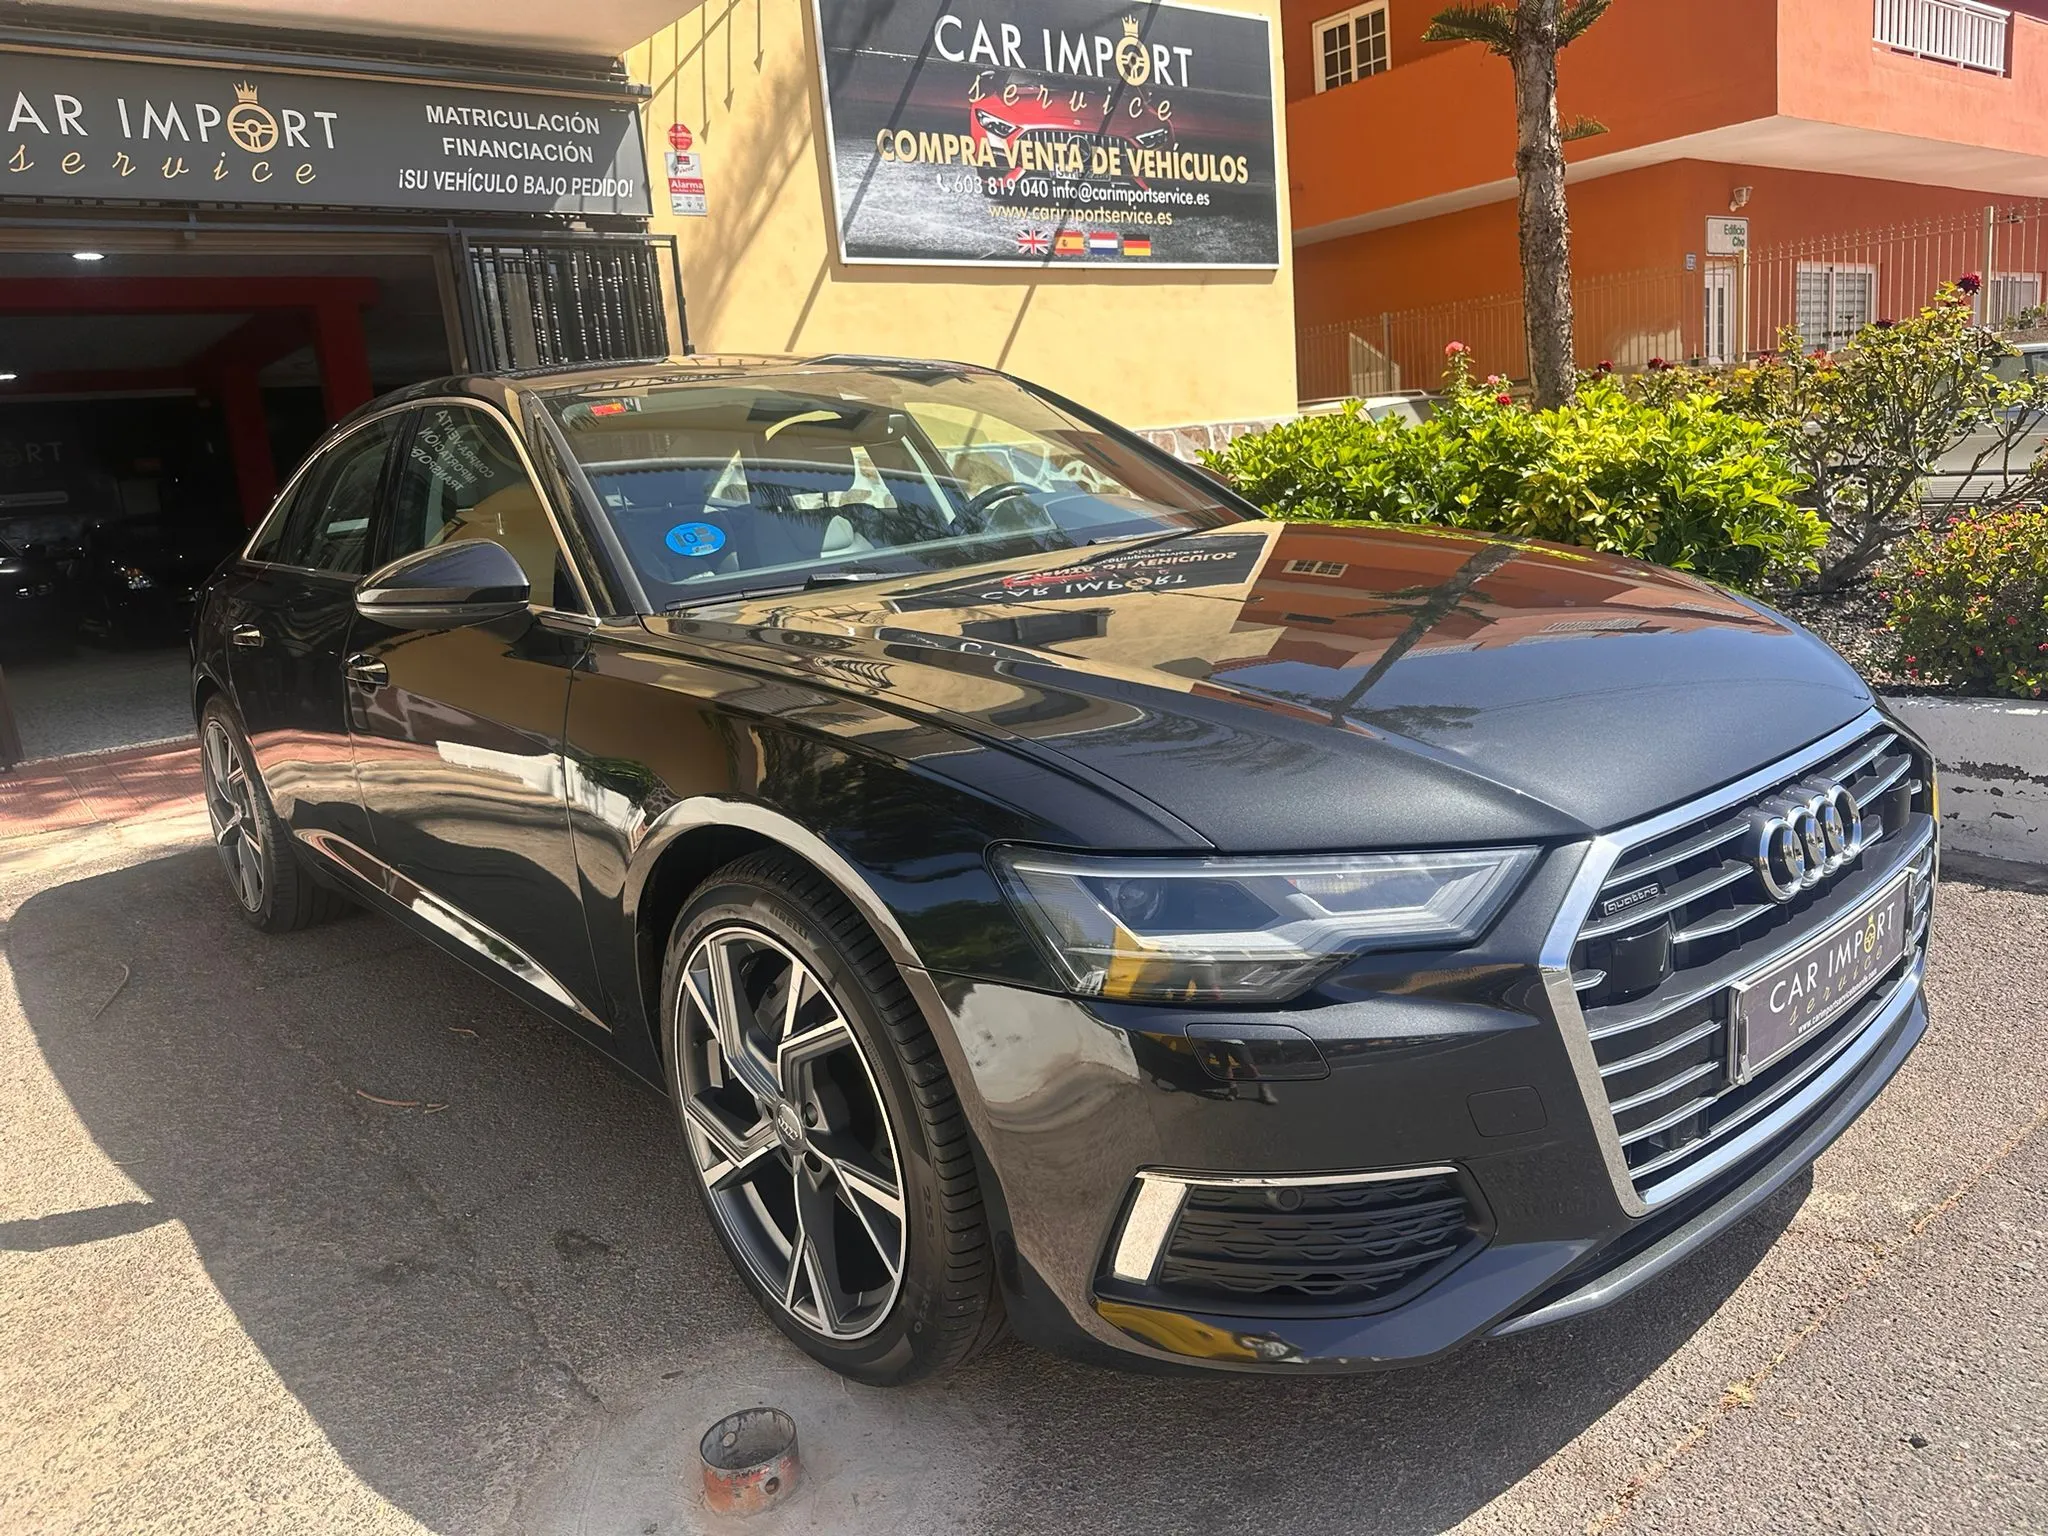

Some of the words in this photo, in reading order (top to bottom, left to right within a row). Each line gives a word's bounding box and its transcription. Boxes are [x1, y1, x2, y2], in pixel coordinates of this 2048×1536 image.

[934, 15, 1026, 69] CAR
[1042, 24, 1193, 87] IMPORT
[968, 71, 1172, 121] service
[8, 91, 88, 136] AR
[117, 94, 338, 153] IMPORT
[425, 104, 600, 135] MATRICULACIÓN
[8, 144, 316, 184] service
[442, 136, 594, 163] FINANCIACIÓN
[877, 128, 996, 168] COMPRA
[1003, 140, 1084, 173] VENTA
[1092, 147, 1122, 177] DE
[1126, 143, 1249, 184] VEHÍCULOS
[399, 169, 428, 190] ¡SU
[433, 168, 518, 193] VEHÍCULO
[523, 177, 567, 197] BAJO
[572, 177, 633, 198] PEDIDO!
[671, 179, 704, 189] Alarma
[954, 175, 983, 194] 603
[988, 176, 1016, 196] 819
[1020, 179, 1049, 198] 040
[1052, 180, 1210, 206] info@carimportservice.es
[988, 203, 1173, 226] www.carimportservice.es
[1607, 886, 1659, 912] quattro
[1769, 961, 1819, 1014] CAR
[1828, 901, 1896, 979] IMPORT
[1788, 945, 1883, 1027] service
